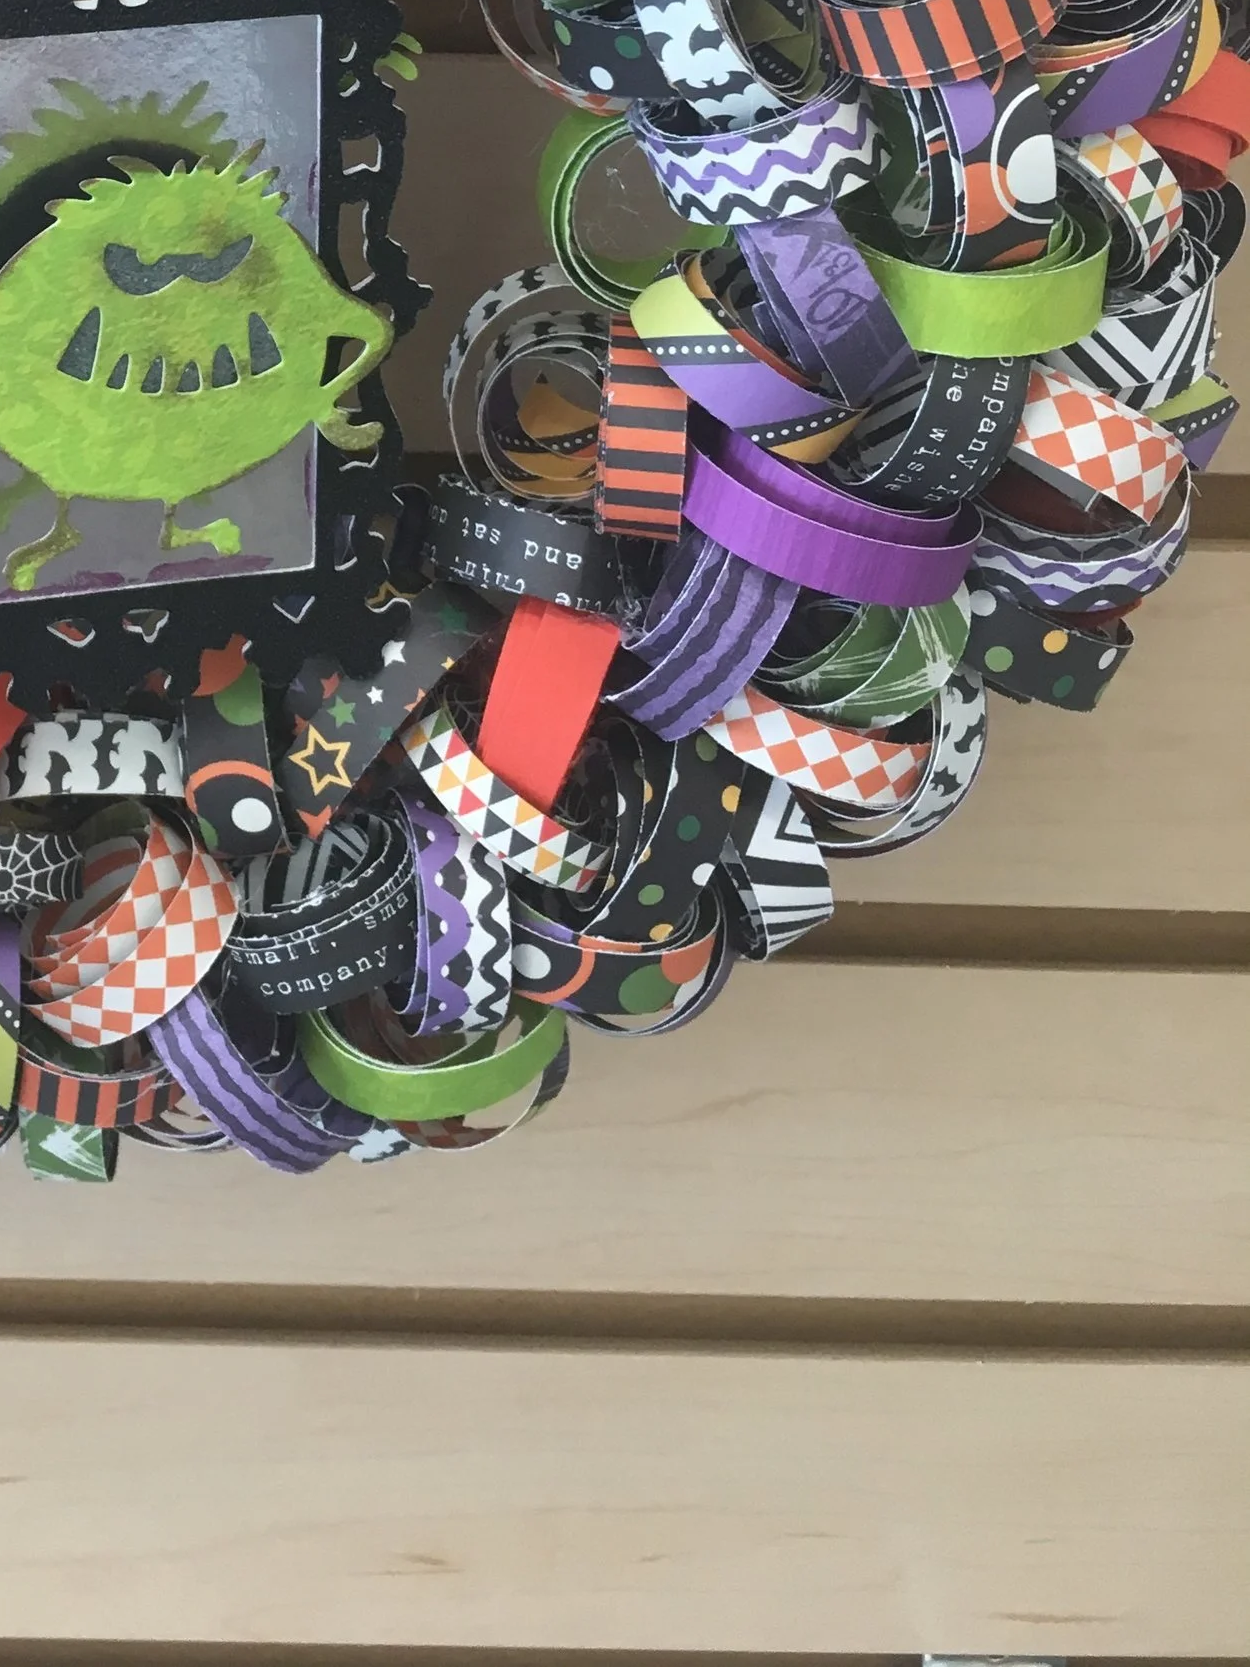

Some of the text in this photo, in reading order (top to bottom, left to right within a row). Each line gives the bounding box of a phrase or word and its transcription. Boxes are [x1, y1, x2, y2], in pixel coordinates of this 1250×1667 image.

[461, 516, 502, 546] sat
[523, 538, 583, 571] and
[259, 944, 405, 1000] company.
